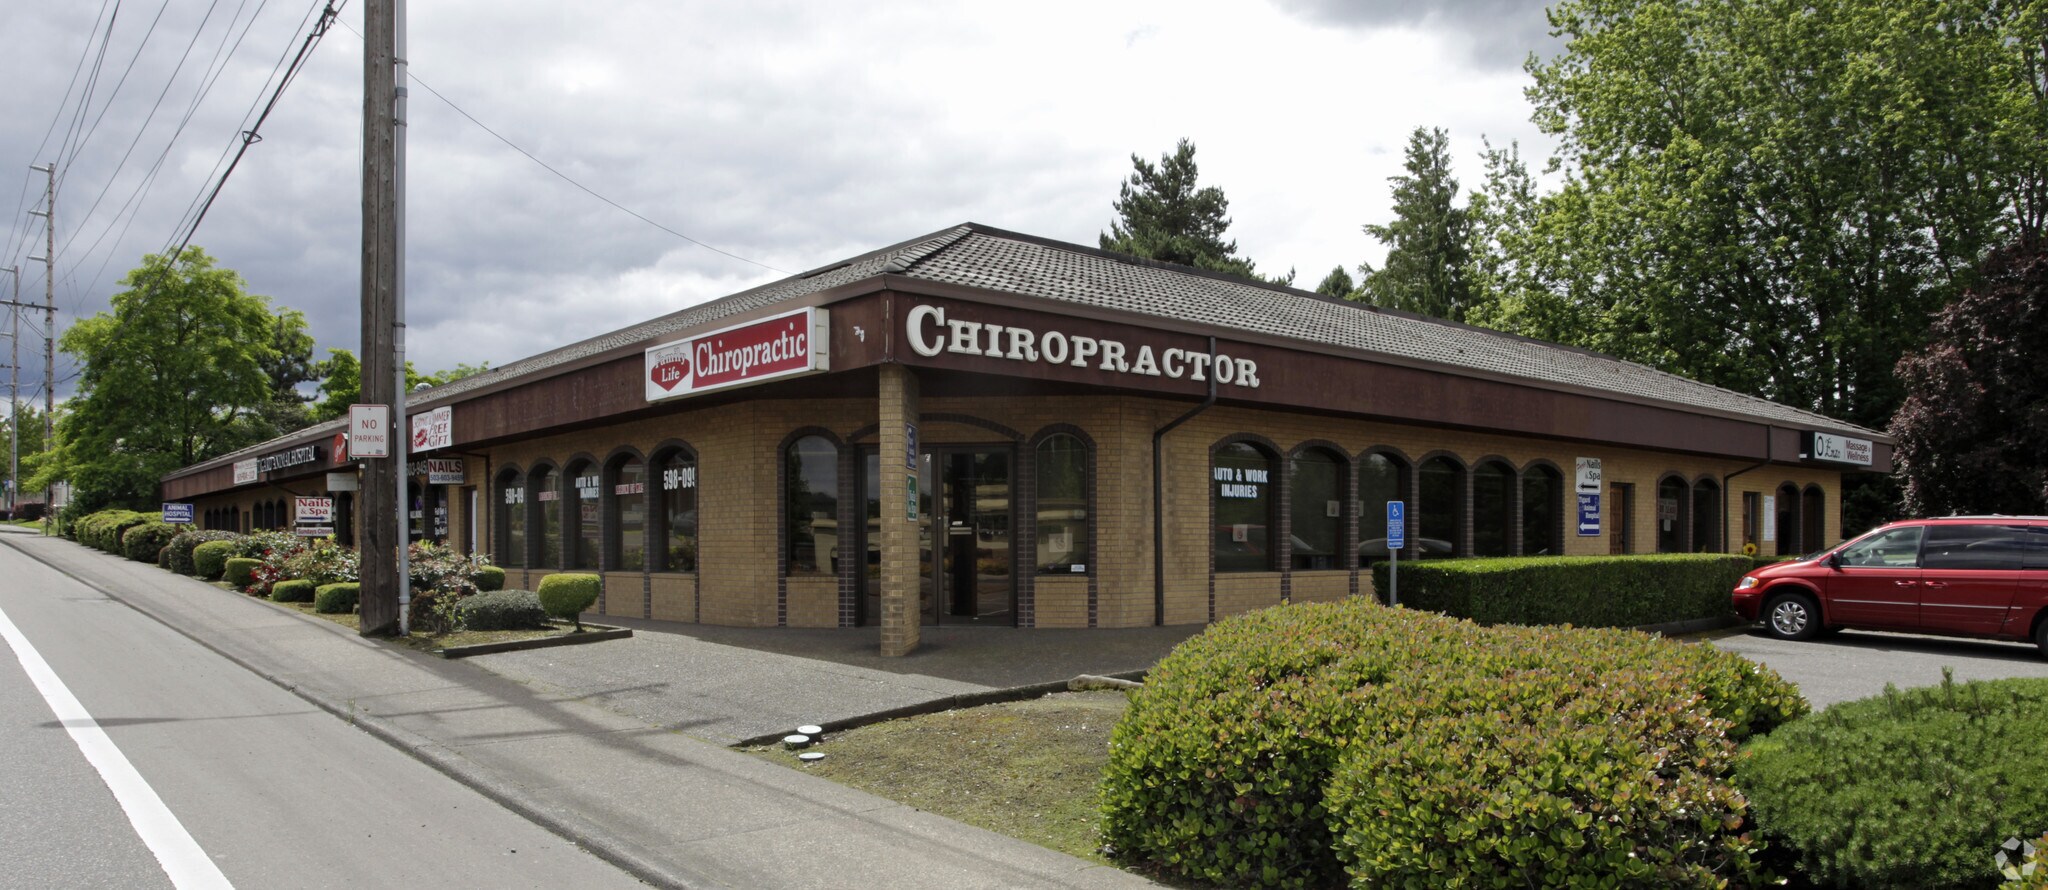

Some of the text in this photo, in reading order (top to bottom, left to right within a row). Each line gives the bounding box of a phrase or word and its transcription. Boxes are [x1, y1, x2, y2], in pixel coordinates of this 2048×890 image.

[695, 322, 807, 380] Chiropractic
[906, 304, 1260, 389] CHIROPRACTOR
[655, 346, 687, 369] Family
[661, 365, 681, 383] Life
[361, 419, 377, 430] NO
[354, 434, 385, 443] PARKING
[1845, 439, 1868, 454] Massage
[1846, 451, 1870, 463] Wellness
[429, 461, 462, 473] NAILS
[1586, 459, 1601, 469] Nails
[1235, 468, 1242, 482] &
[1245, 469, 1268, 484] WORK
[1589, 471, 1601, 482] Spa
[1221, 483, 1258, 498] INJURIES
[298, 498, 331, 507] Nails
[164, 510, 192, 518] HOSPITAL
[309, 507, 329, 516] Spa
